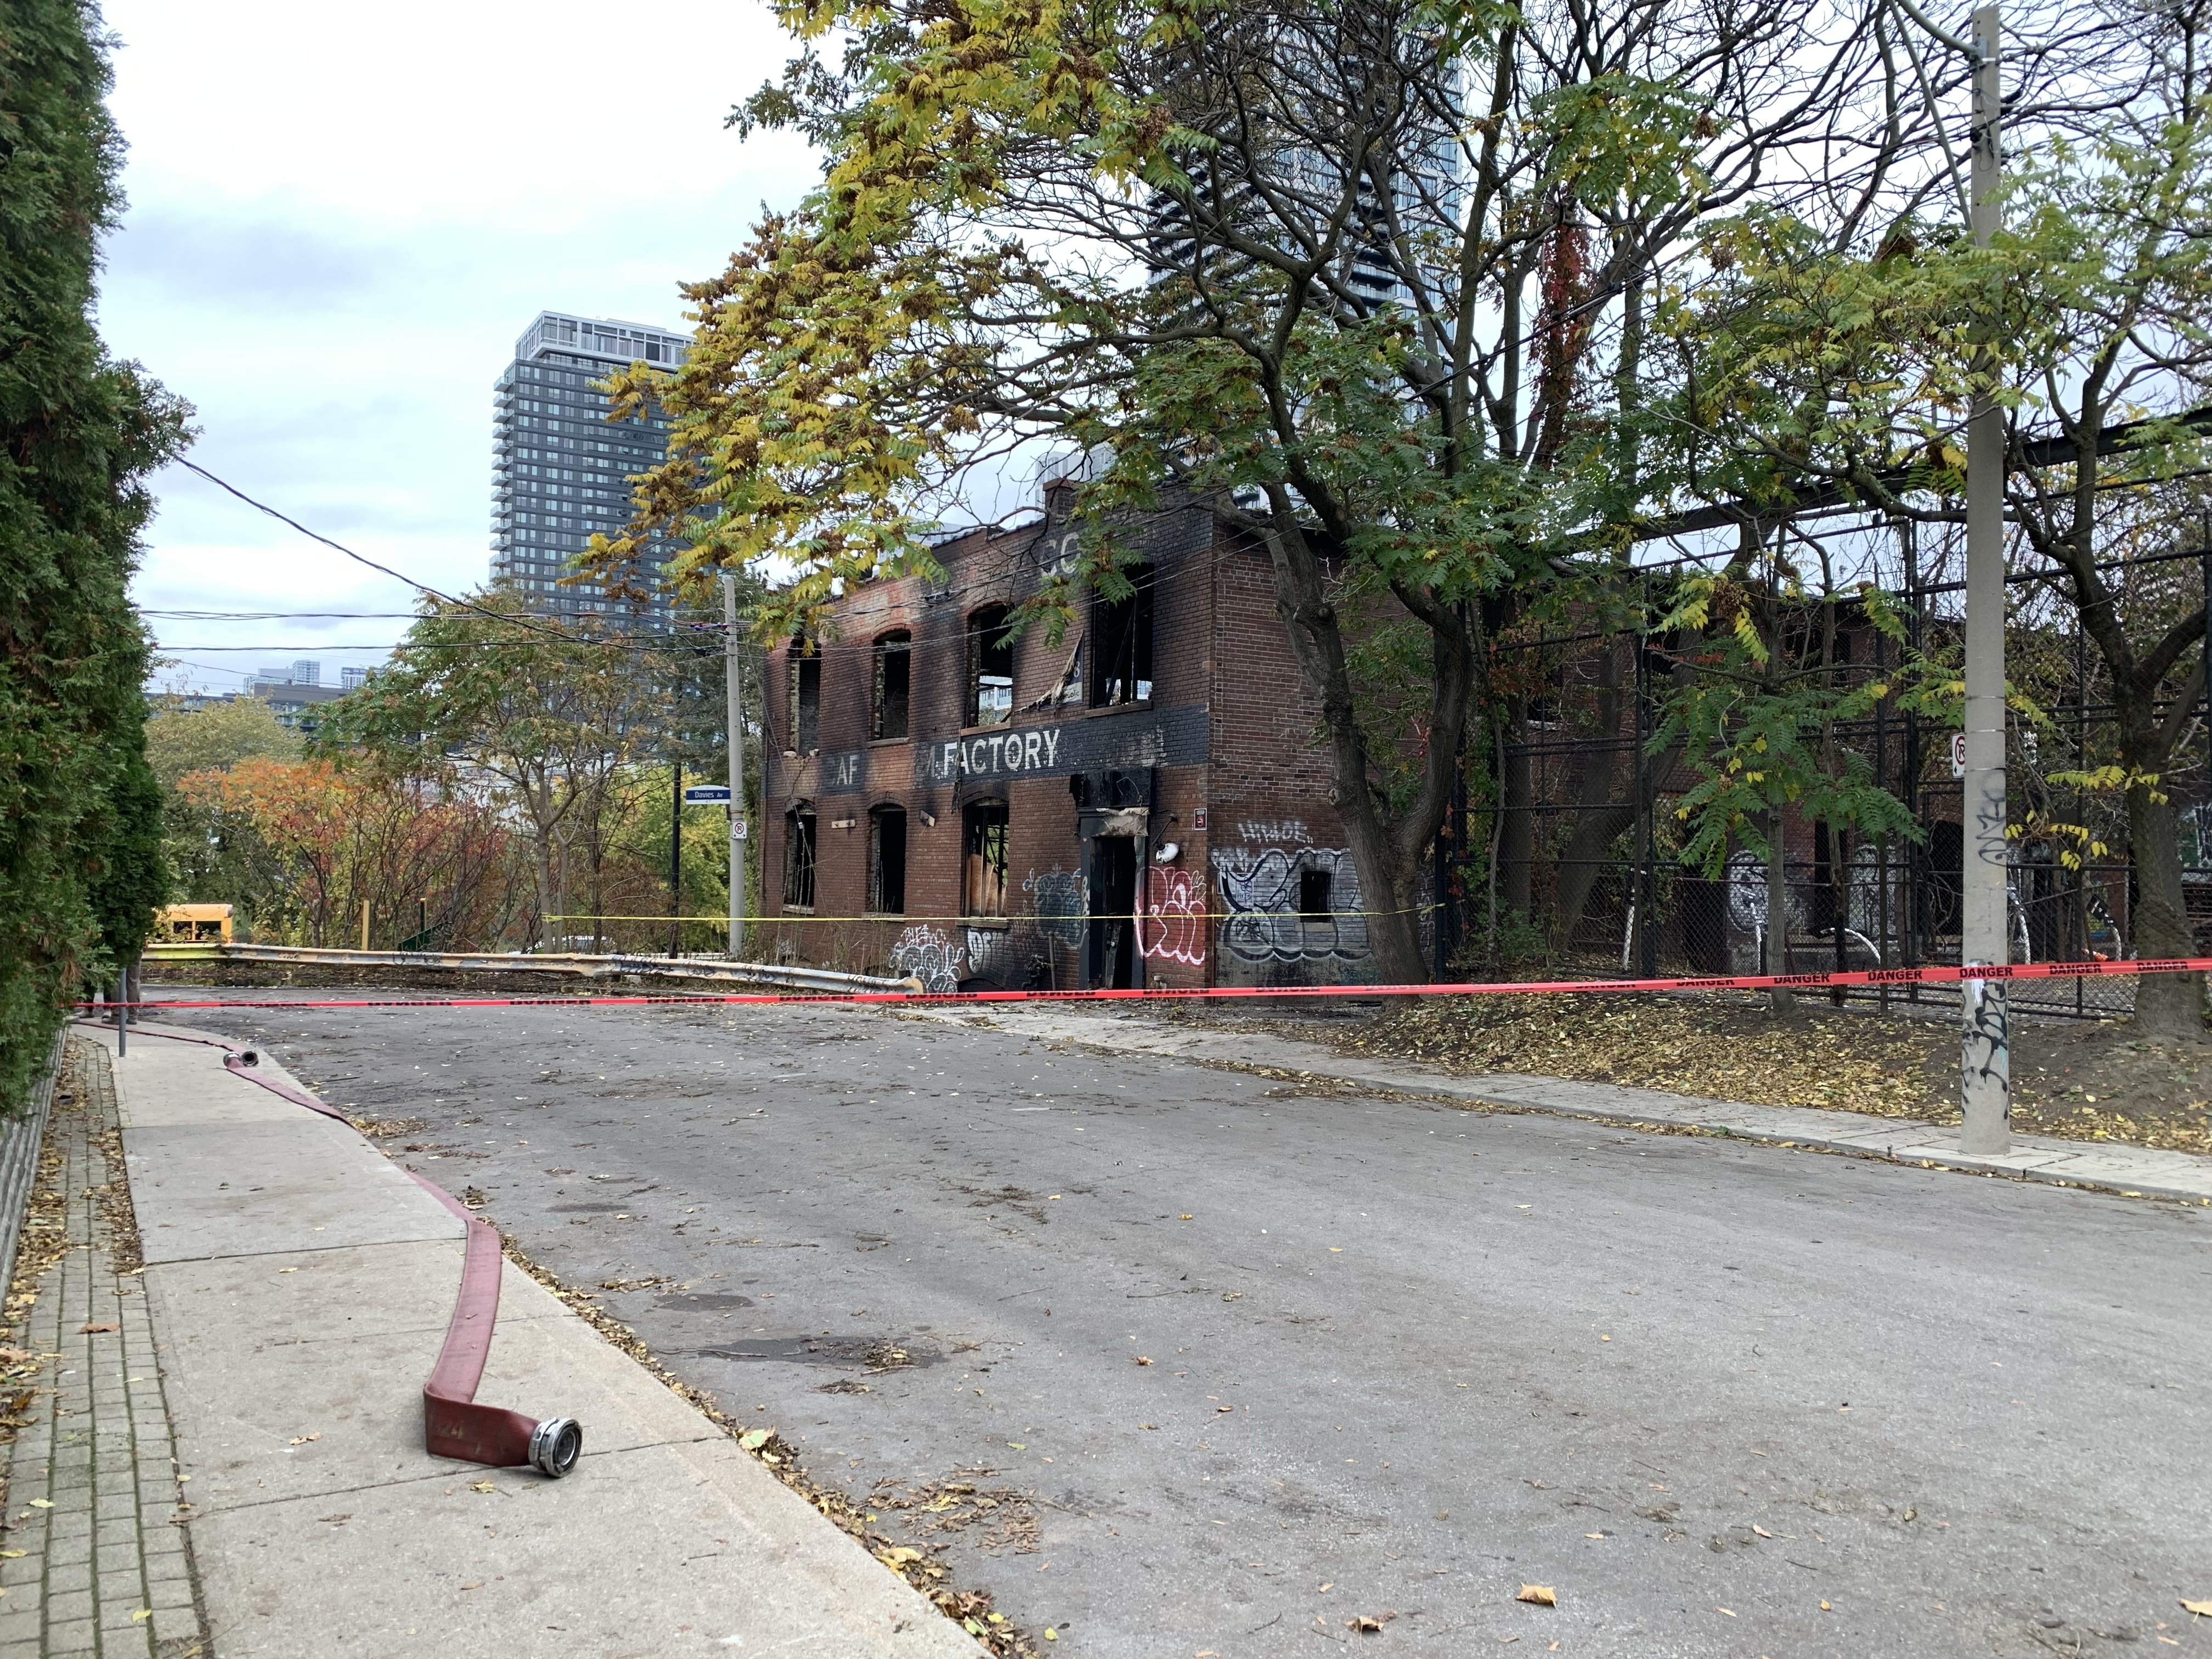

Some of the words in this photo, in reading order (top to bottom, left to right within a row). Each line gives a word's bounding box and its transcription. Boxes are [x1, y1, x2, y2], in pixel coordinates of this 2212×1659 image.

[944, 729, 1060, 776] FACTORY
[1774, 973, 1830, 984] DANGER
[1868, 970, 1922, 981] DANGER
[1959, 967, 2013, 978] DANGER
[2049, 964, 2102, 975] DANGER
[2136, 961, 2188, 972] DANGER
